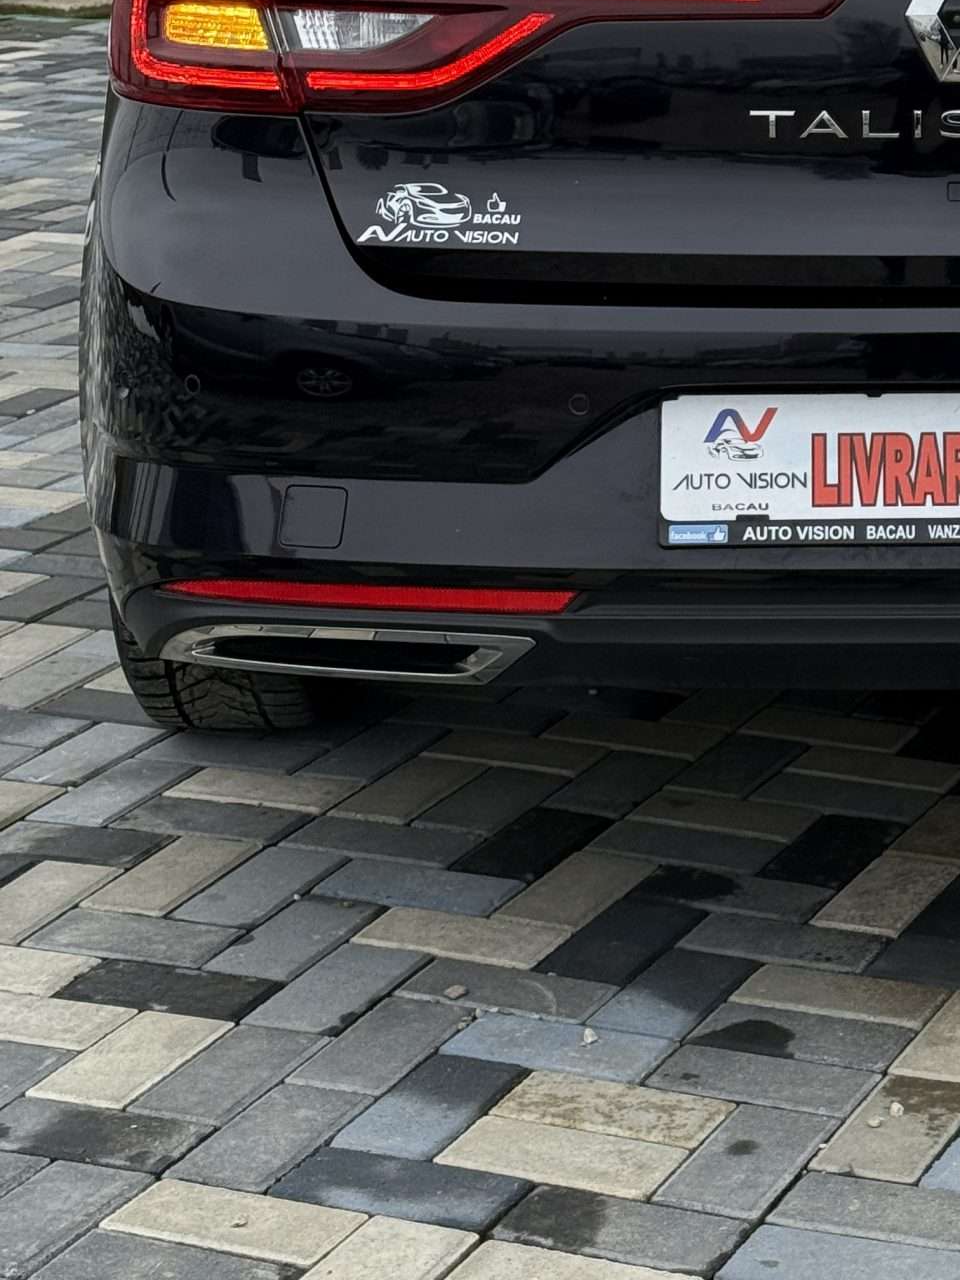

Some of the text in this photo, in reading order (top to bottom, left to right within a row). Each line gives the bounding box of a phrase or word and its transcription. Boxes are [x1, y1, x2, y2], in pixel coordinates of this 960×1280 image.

[473, 213, 521, 225] BACAU
[395, 230, 449, 243] AUTO
[454, 230, 519, 244] VISION
[672, 472, 808, 490] AUTO VISION
[712, 502, 769, 511] BACAU
[742, 526, 792, 541] AUTO
[796, 525, 855, 540] VISION
[866, 525, 916, 540] BACAU
